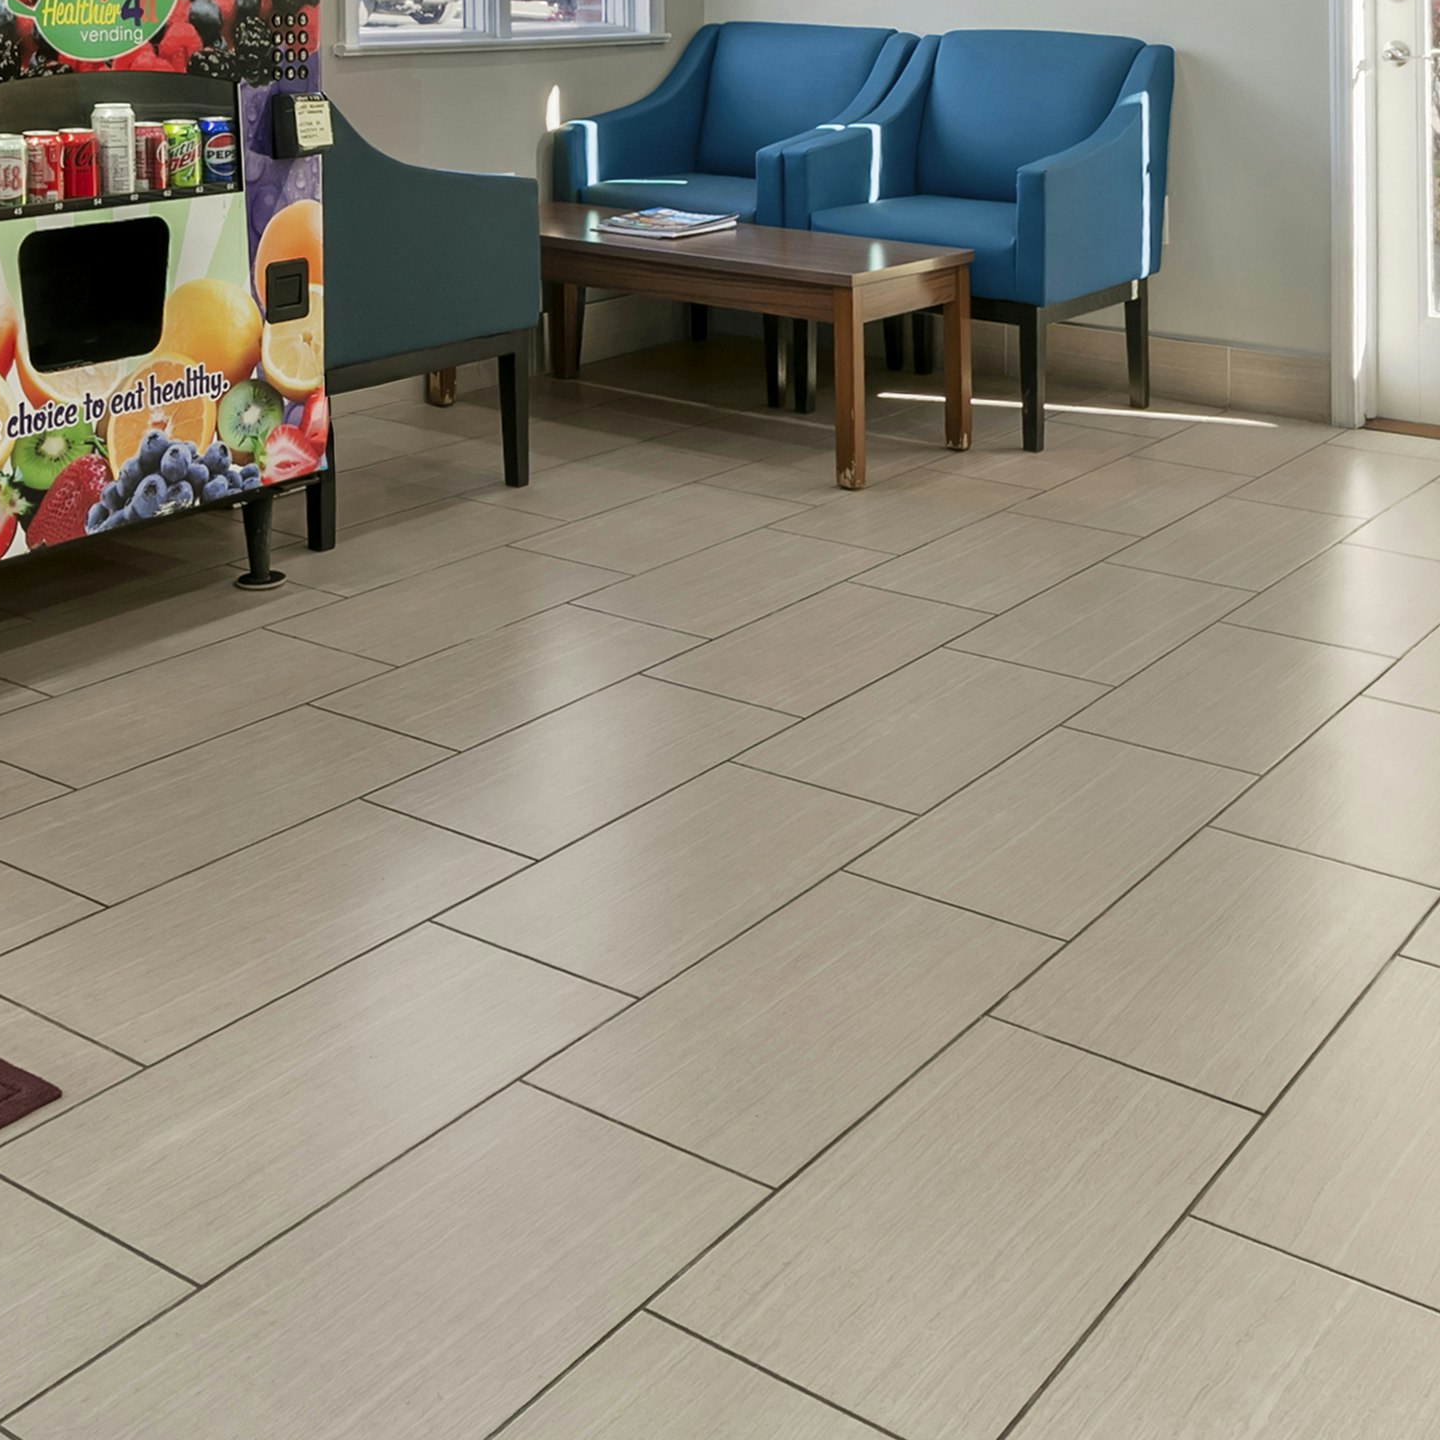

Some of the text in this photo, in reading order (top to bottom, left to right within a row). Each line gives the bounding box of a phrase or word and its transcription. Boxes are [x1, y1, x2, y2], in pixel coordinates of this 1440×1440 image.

[80, 26, 144, 44] vending
[94, 198, 102, 206] 54
[8, 402, 77, 438] choice
[83, 393, 105, 421] to
[111, 382, 145, 414] eat
[149, 364, 229, 406] healthy.
